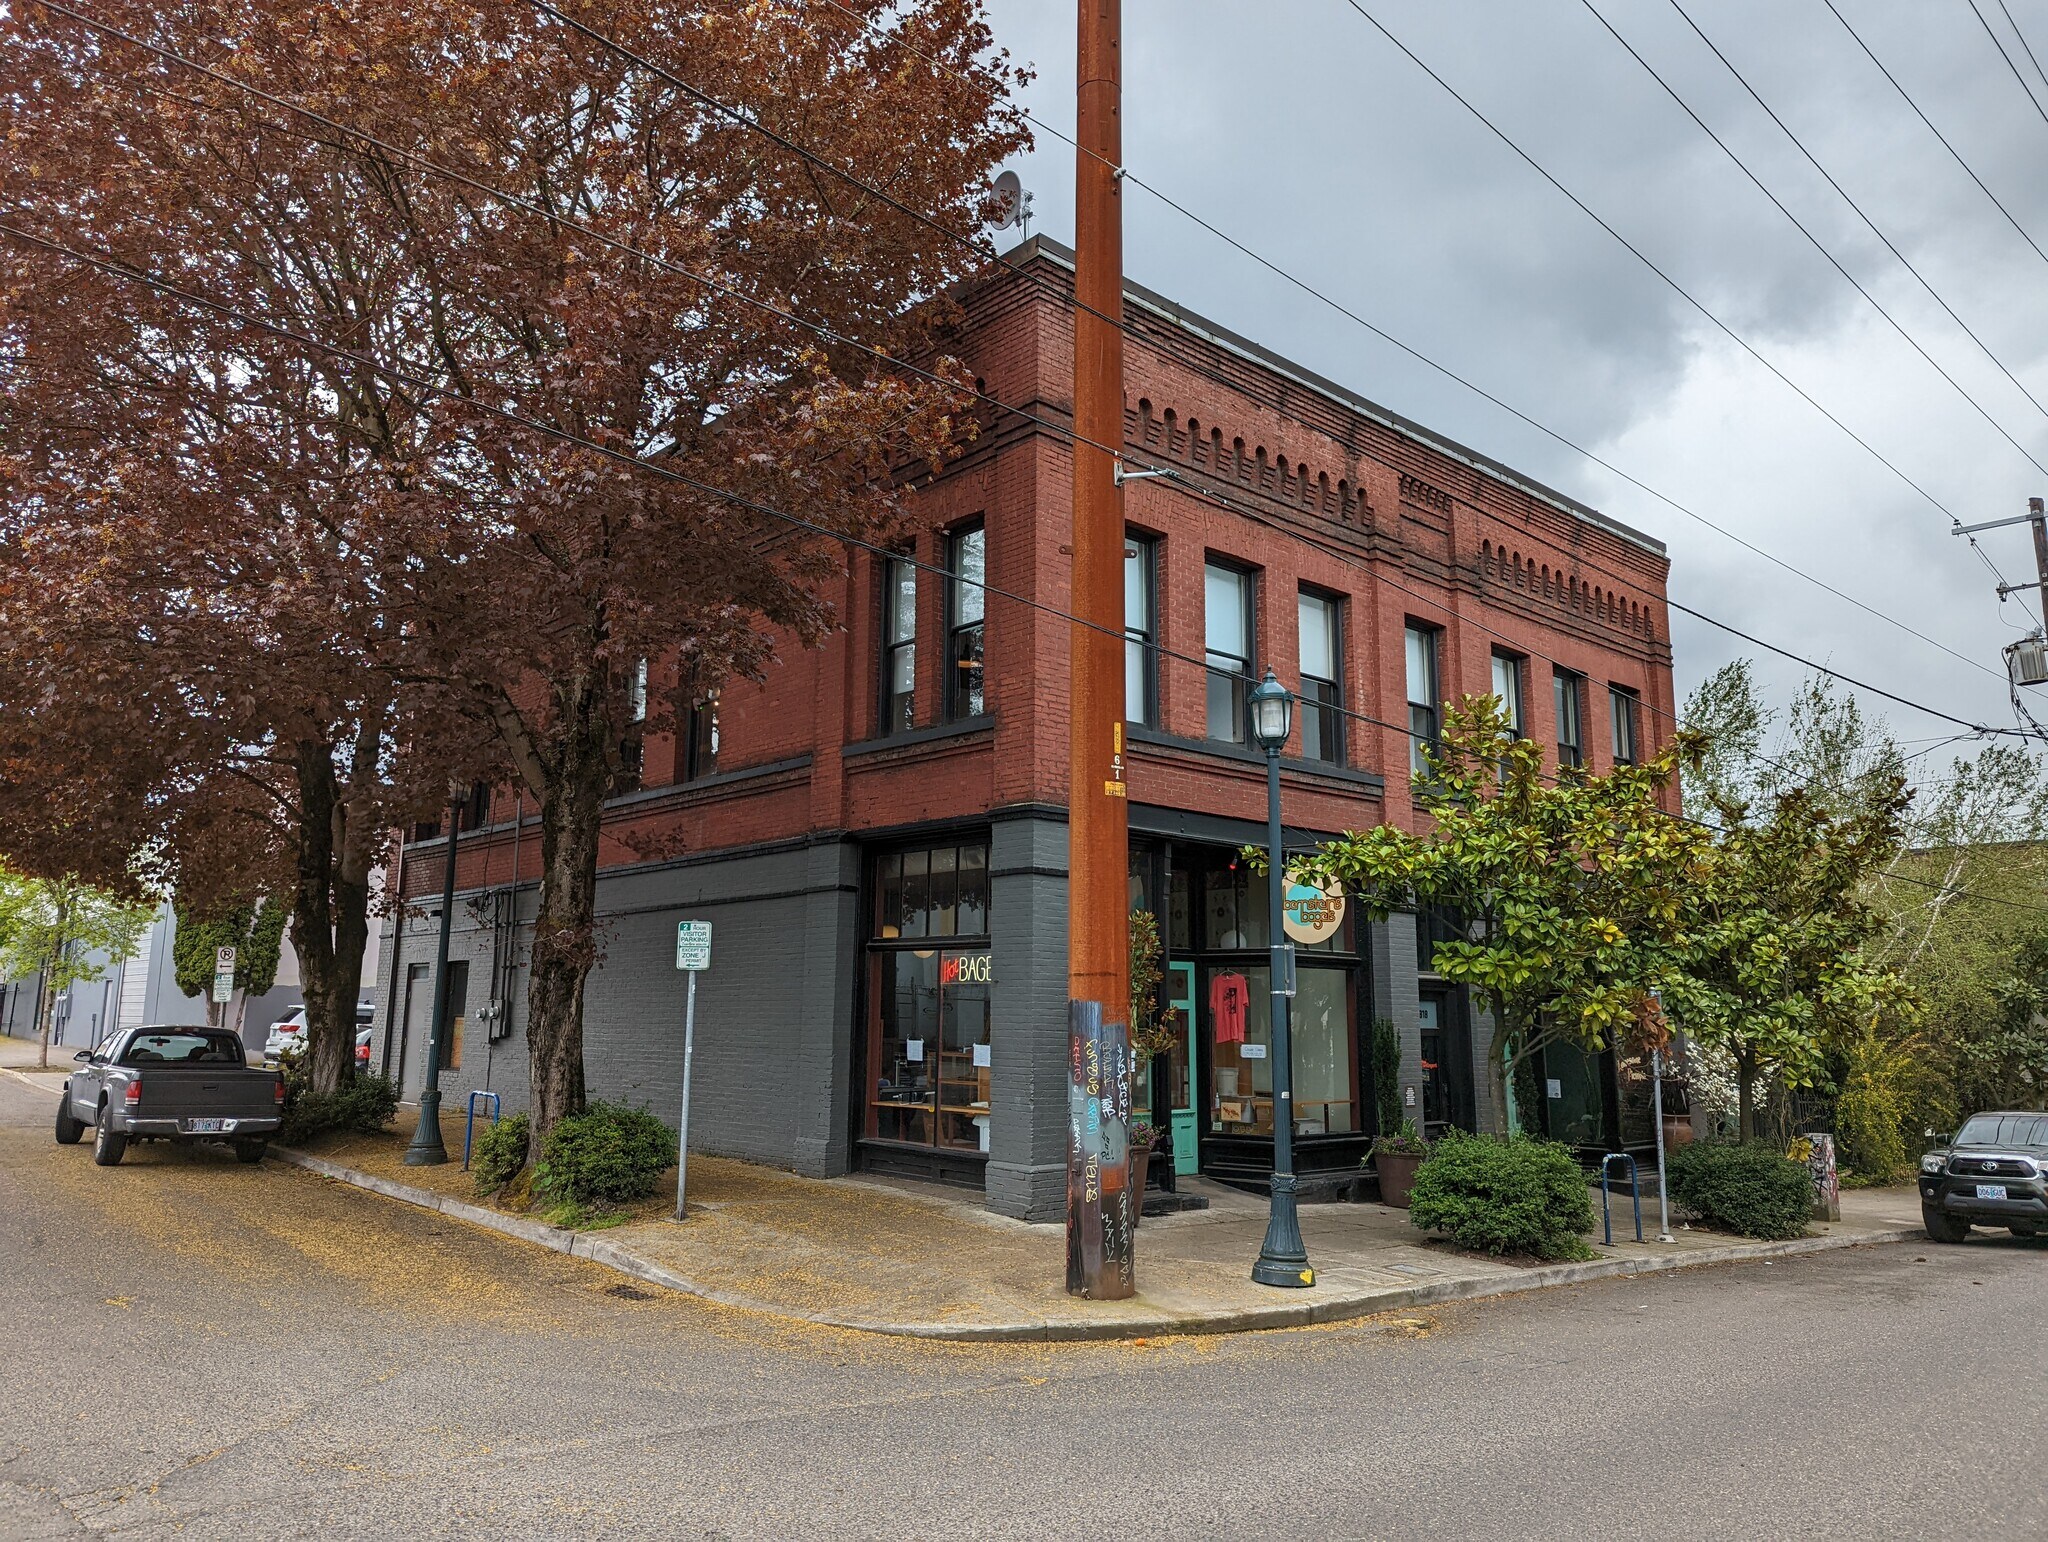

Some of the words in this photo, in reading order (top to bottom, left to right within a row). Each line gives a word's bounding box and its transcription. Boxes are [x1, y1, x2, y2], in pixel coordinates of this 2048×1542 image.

[1114, 755, 1120, 764] 6
[1115, 769, 1120, 779] 1
[1301, 909, 1336, 930] bagels
